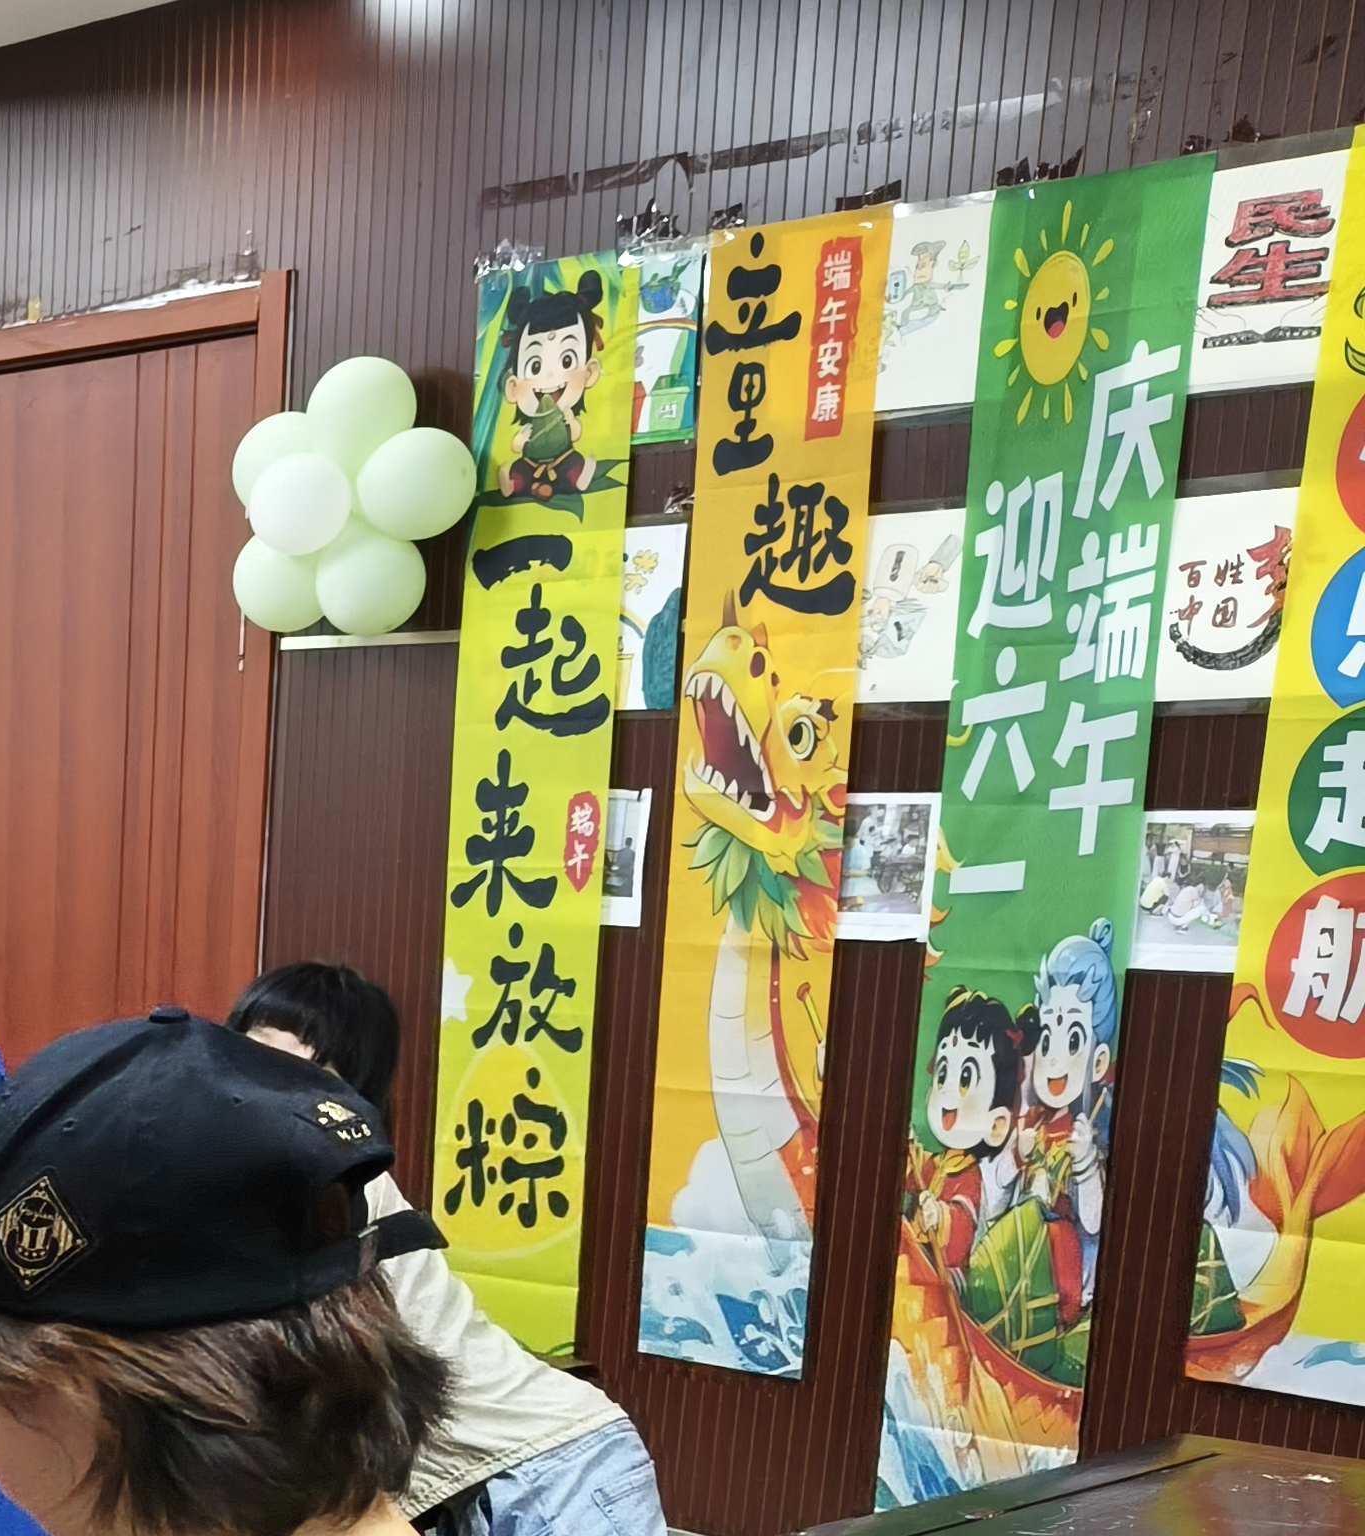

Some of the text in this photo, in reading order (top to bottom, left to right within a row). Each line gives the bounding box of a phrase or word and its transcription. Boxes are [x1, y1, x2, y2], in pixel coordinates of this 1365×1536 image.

[1207, 188, 1336, 309] 民生
[811, 250, 853, 423] 端午安康
[1048, 340, 1181, 857] 庆端午
[1177, 594, 1238, 637] 中国
[1178, 553, 1245, 589] 百姓
[948, 471, 1065, 895] 迎六一
[443, 533, 611, 1228] 一起来放粽
[568, 803, 595, 880] 端午
